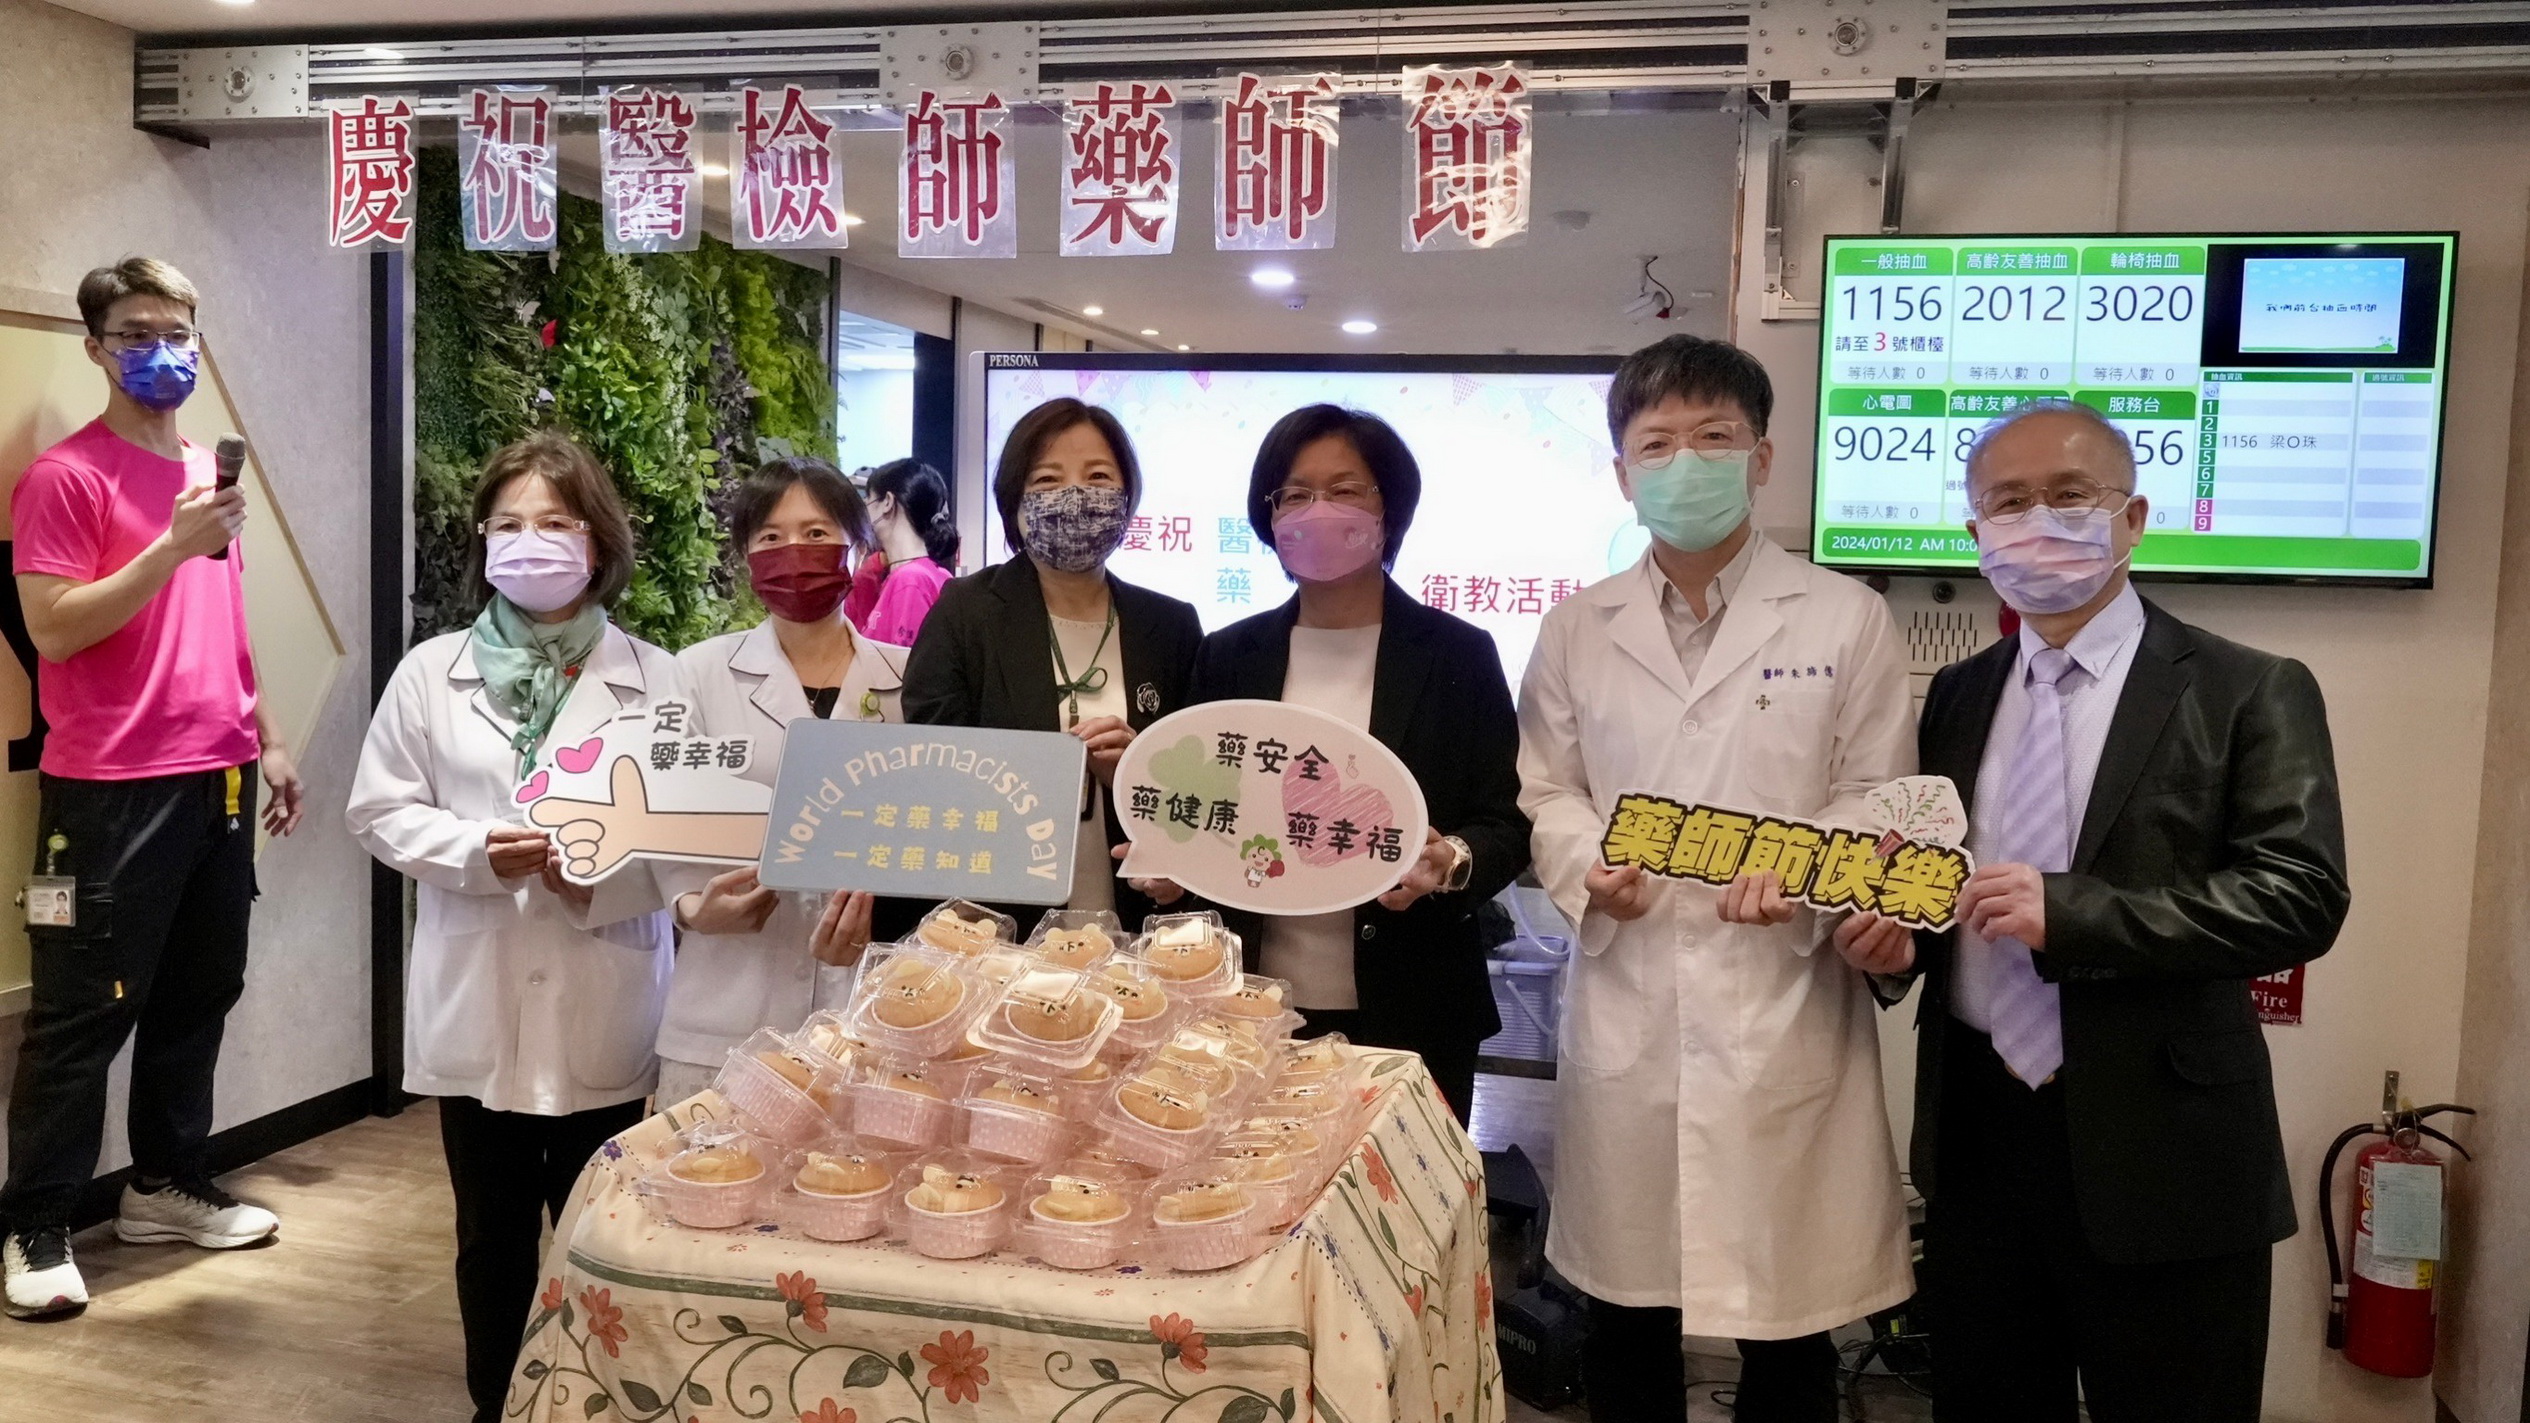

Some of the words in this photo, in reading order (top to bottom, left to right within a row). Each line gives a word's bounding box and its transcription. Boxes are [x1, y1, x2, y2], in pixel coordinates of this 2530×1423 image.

[329, 72, 1526, 246] 慶祝醫檢師藥師節
[1861, 253, 1927, 270] 一般抽血
[1966, 252, 2068, 270] 高齡友善抽血
[2110, 252, 2180, 269] 輪椅抽血
[1843, 285, 1942, 321] 1156
[1961, 285, 2066, 321] 2012
[2086, 285, 2193, 321] 3020
[1835, 335, 1869, 352] 請至
[1874, 331, 1887, 351] 3
[989, 354, 1039, 367] PERSONA
[1847, 366, 1906, 380] 等待人數
[1916, 366, 1926, 380] 0
[1968, 366, 2029, 381] 等待人數
[2039, 367, 2050, 381] 0
[2093, 367, 2154, 381] 等待人數
[2165, 368, 2175, 381] 0
[1862, 394, 1912, 411] 心電圖
[2108, 396, 2160, 413] 服務台
[2206, 400, 2213, 413] 1
[2204, 418, 2214, 431] 2
[1834, 425, 1936, 462] 9024
[2203, 434, 2213, 447] 3
[2222, 435, 2258, 449] 1156
[2202, 450, 2211, 464] 5
[2201, 466, 2211, 480] 6
[2200, 483, 2209, 496] 7
[1841, 504, 1899, 519] 等待人數
[1909, 507, 1919, 520] 0
[2199, 500, 2209, 513] 8
[2156, 511, 2166, 525] 0
[2198, 516, 2208, 530] 9
[1123, 514, 1192, 552] 慶祝
[1831, 535, 1913, 552] 2024/01/12
[1919, 537, 1944, 551] AM
[1216, 567, 1251, 604] 藥
[617, 700, 688, 734] 一定
[650, 739, 748, 772] 藥幸福
[1215, 731, 1329, 782] 藥安全
[774, 776, 845, 864] World
[844, 742, 1039, 816] Pharmacists
[1025, 818, 1058, 881] Day
[1130, 784, 1240, 835] 藥健康
[840, 803, 1000, 834] 一定藥幸福
[1285, 811, 1404, 863] 藥幸福
[833, 843, 993, 875] 一定藥知道
[1601, 795, 1971, 927] 藥師節快樂
[1497, 1322, 1537, 1355] MIPRO
